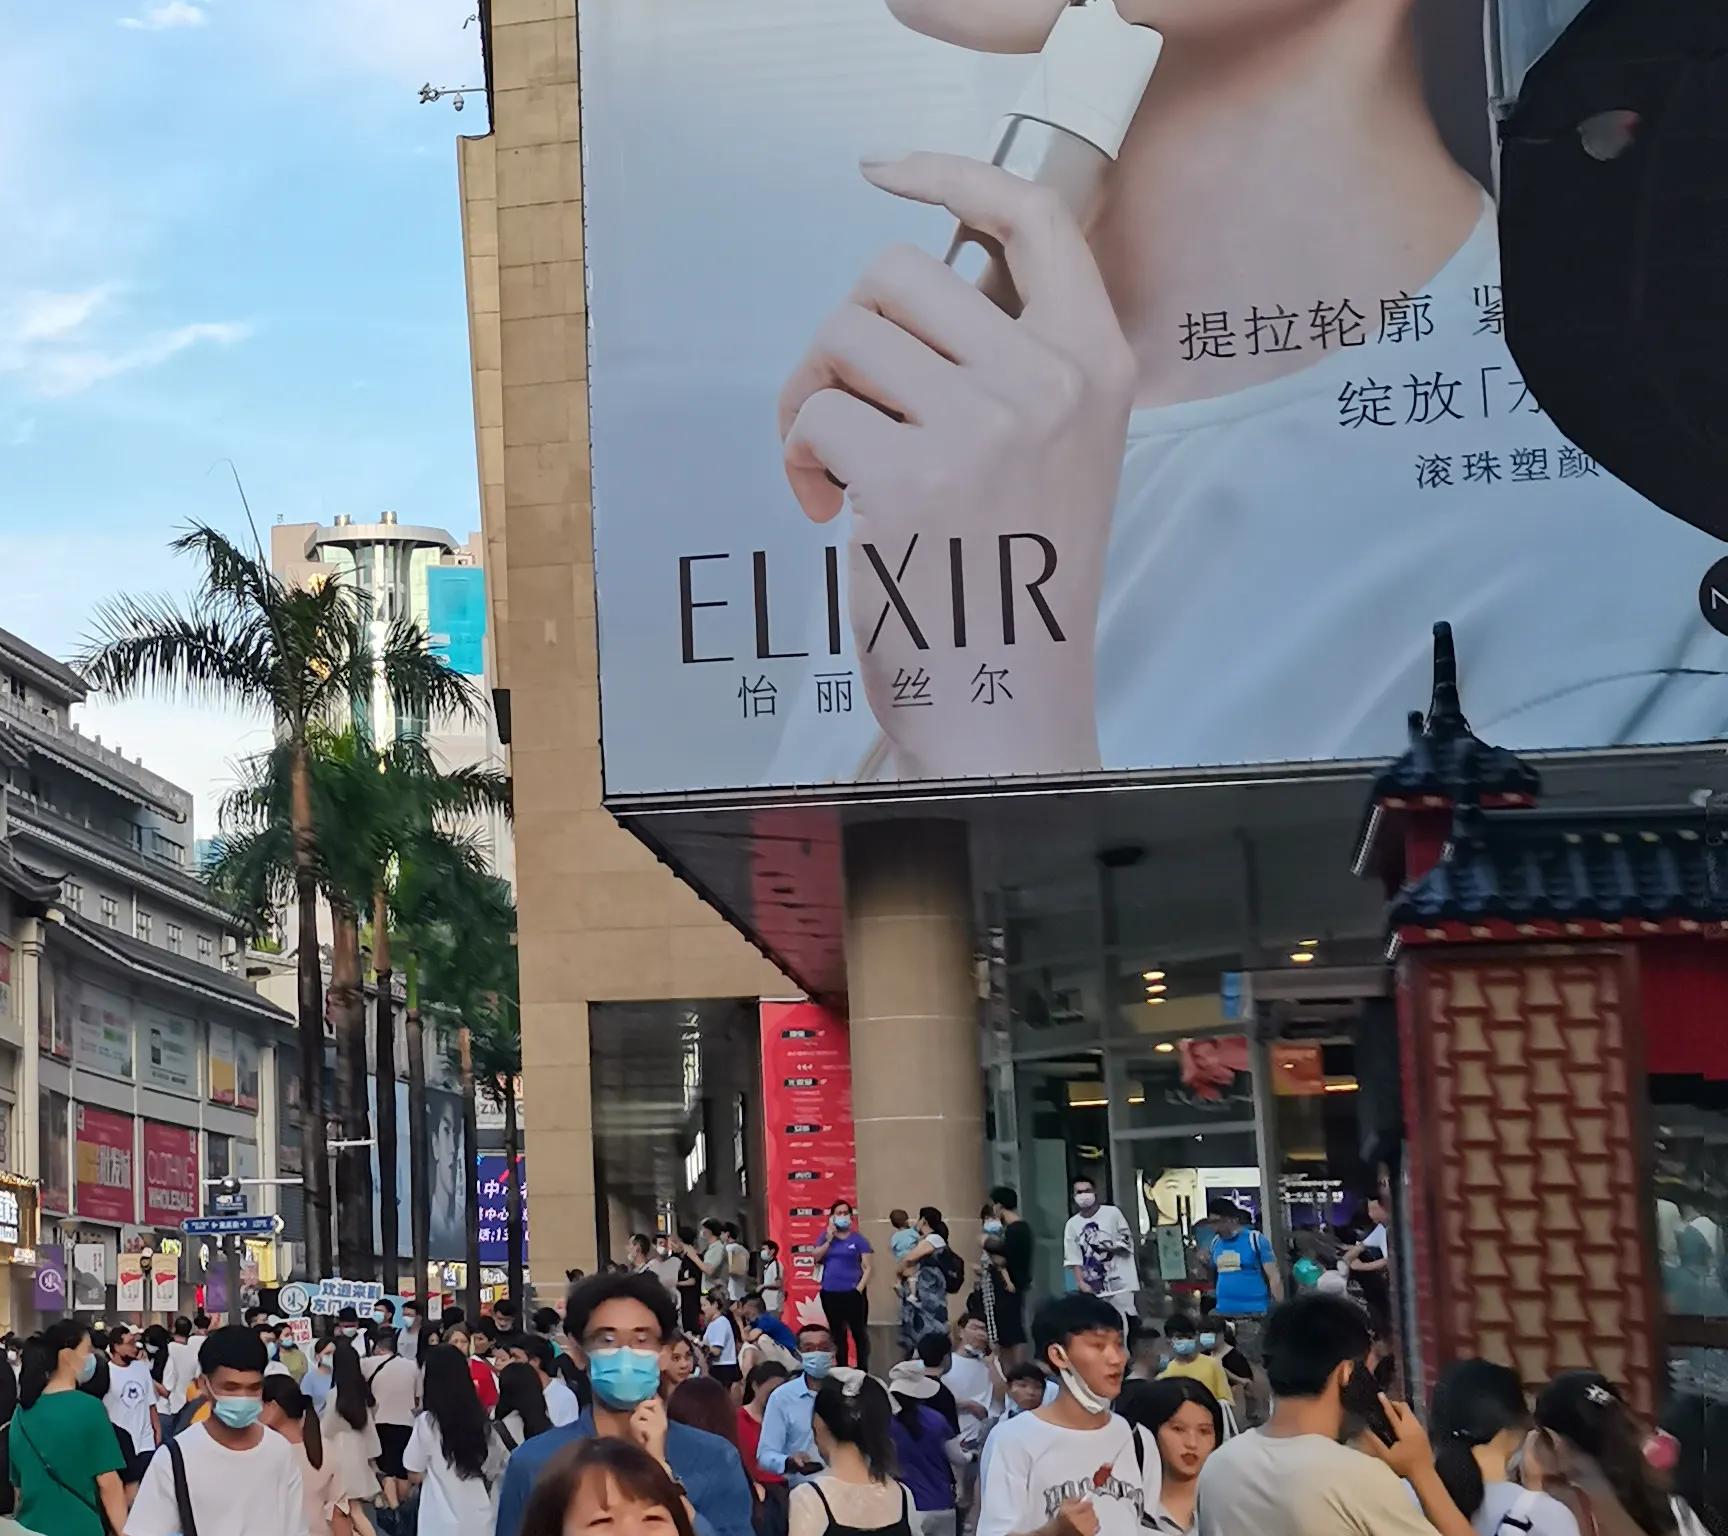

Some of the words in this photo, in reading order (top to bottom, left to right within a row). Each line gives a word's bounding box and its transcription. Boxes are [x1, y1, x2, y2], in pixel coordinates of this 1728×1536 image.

[1178, 290, 1435, 362] 提拉轮廓
[678, 532, 1068, 664] ELIXIR
[736, 662, 1015, 719] 怡丽丝尔
